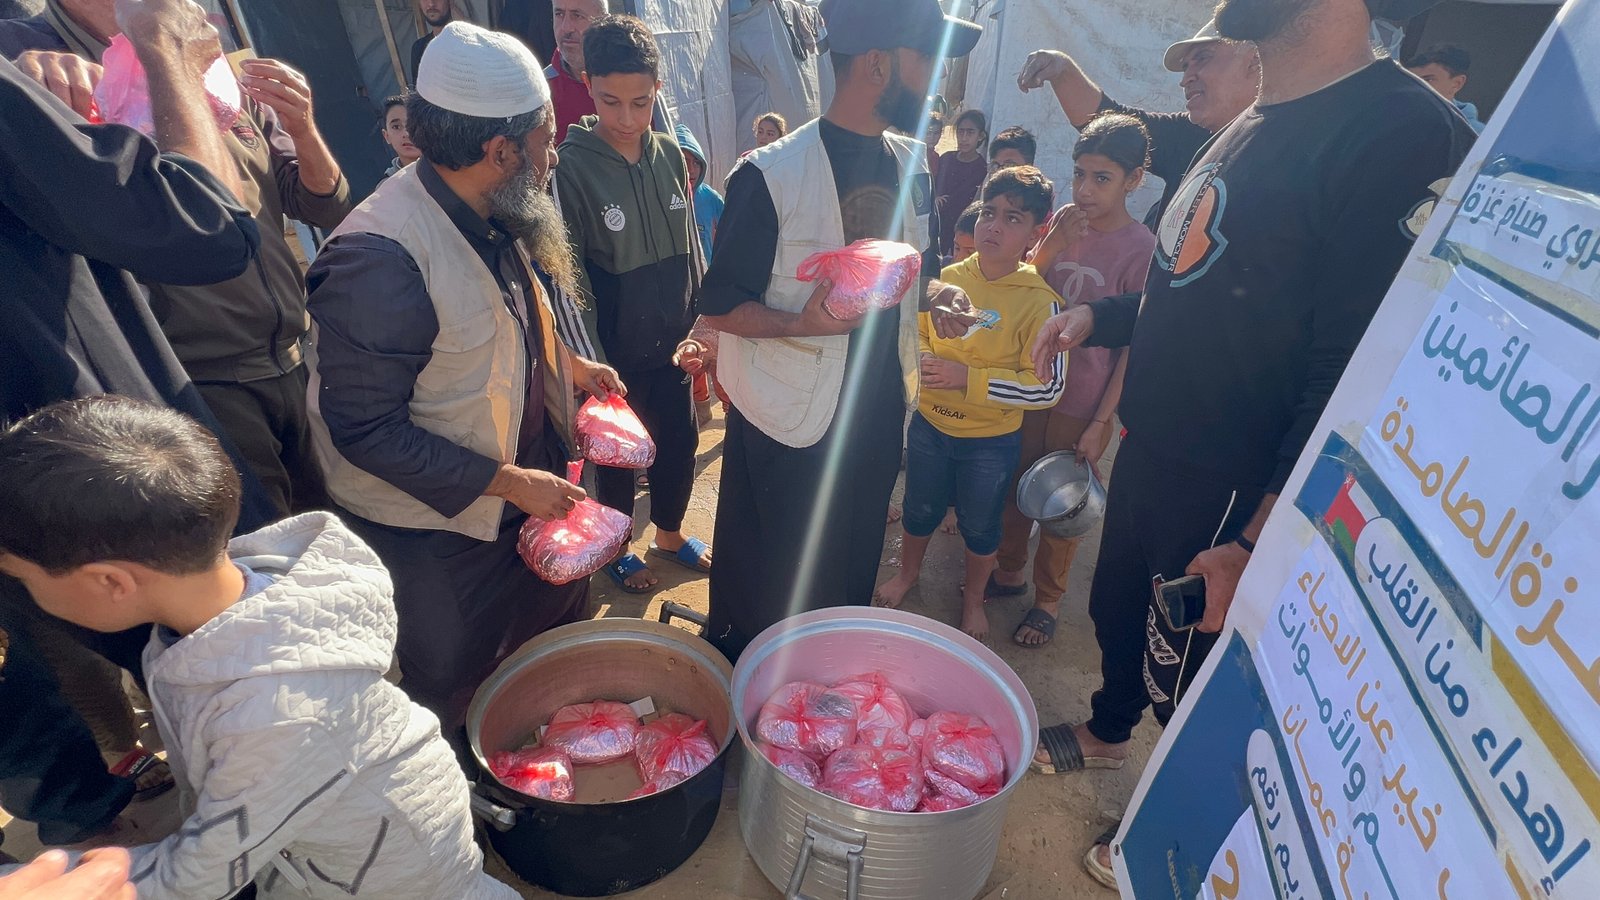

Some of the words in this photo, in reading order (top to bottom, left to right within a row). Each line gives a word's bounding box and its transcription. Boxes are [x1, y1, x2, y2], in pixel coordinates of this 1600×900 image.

[1189, 162, 1223, 214] MONCLER
[1463, 183, 1506, 225] غزة
[1167, 219, 1191, 272] MONCLER
[1545, 223, 1600, 271] روي
[931, 404, 967, 421] KidsAir
[1423, 301, 1600, 462] الصائمين
[1380, 396, 1530, 581] الصامدة
[1368, 543, 1438, 644] القلب
[1424, 639, 1470, 718] من
[1356, 679, 1394, 754] عن
[1251, 766, 1281, 831] رقم
[1381, 763, 1442, 853] خير
[1472, 727, 1591, 896] إهداء
